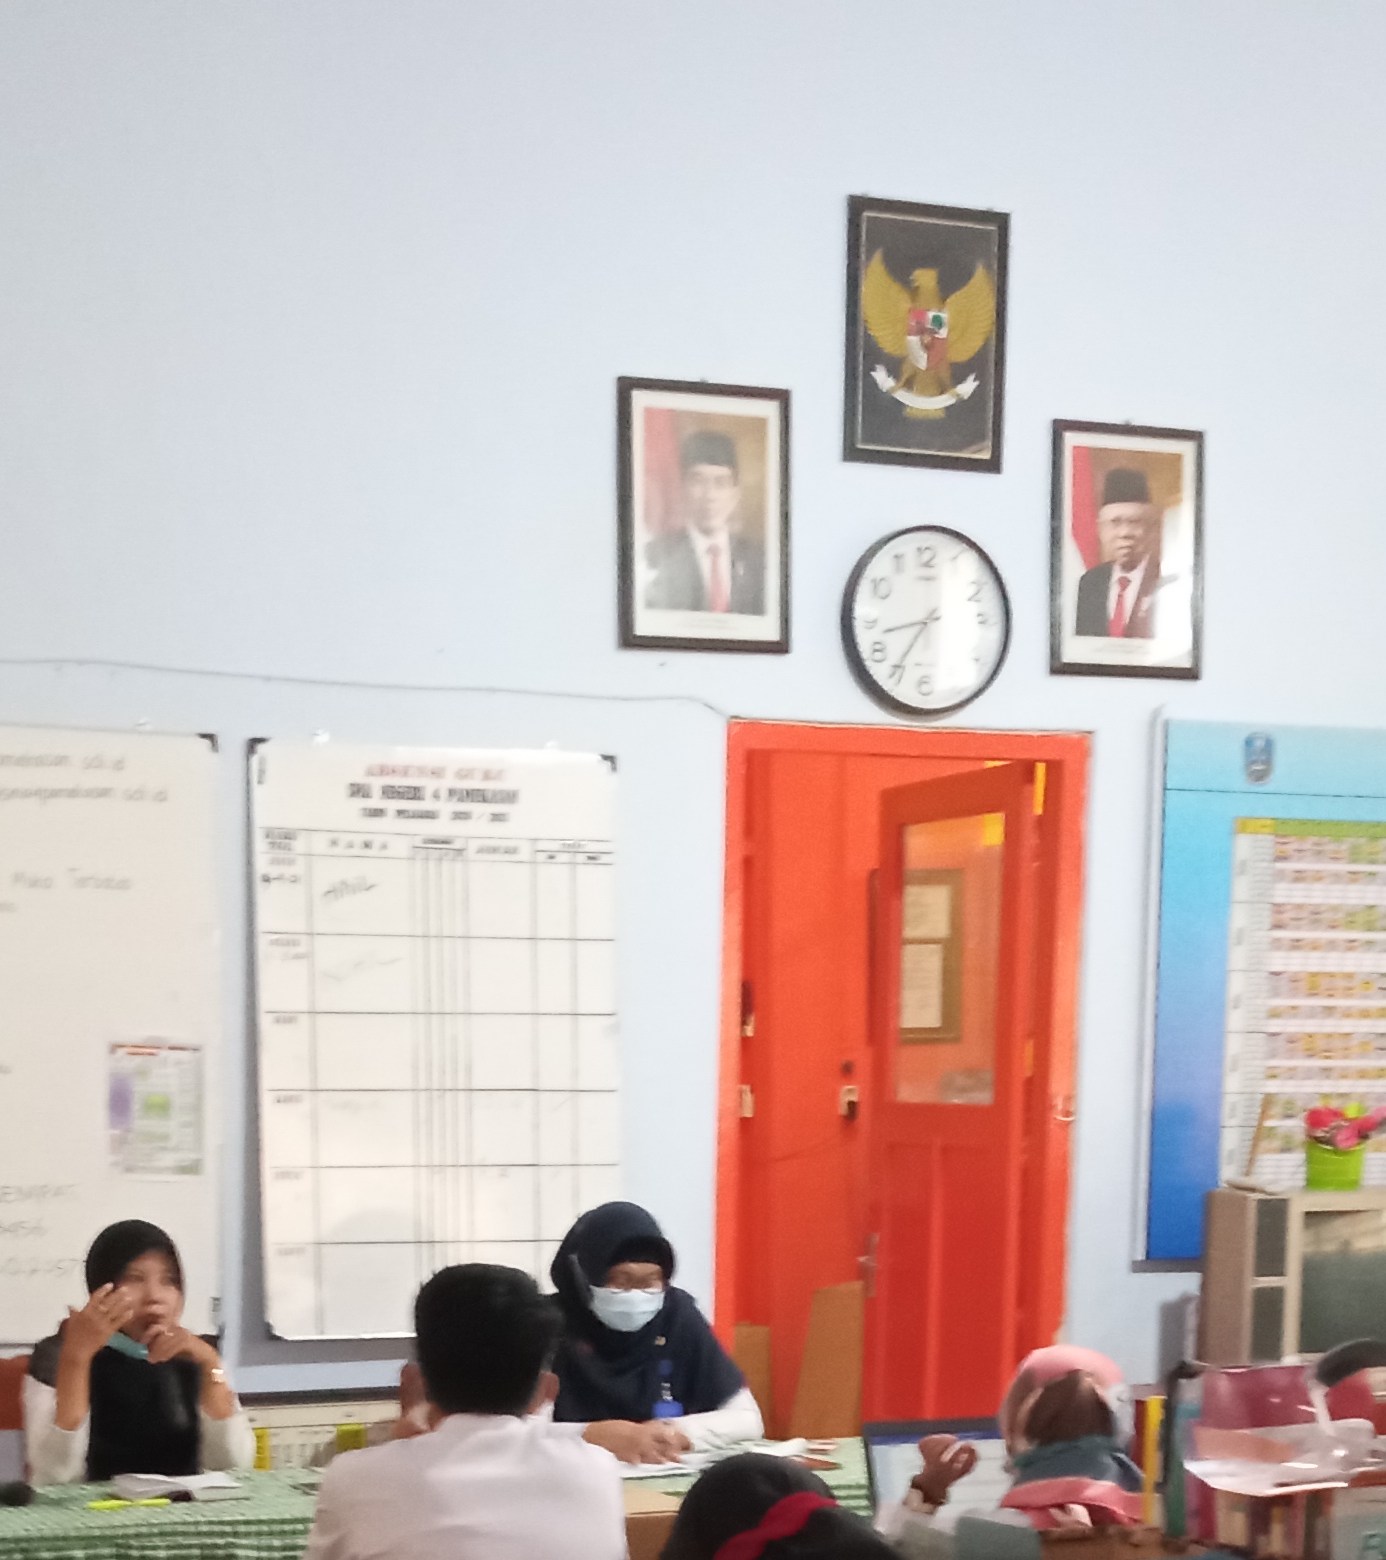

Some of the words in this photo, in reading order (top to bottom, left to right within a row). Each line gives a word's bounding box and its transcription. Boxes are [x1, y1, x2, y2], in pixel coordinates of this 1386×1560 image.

[916, 547, 936, 568] 12
[871, 577, 891, 600] 10
[871, 641, 887, 663] 8
[918, 675, 933, 696] 6
